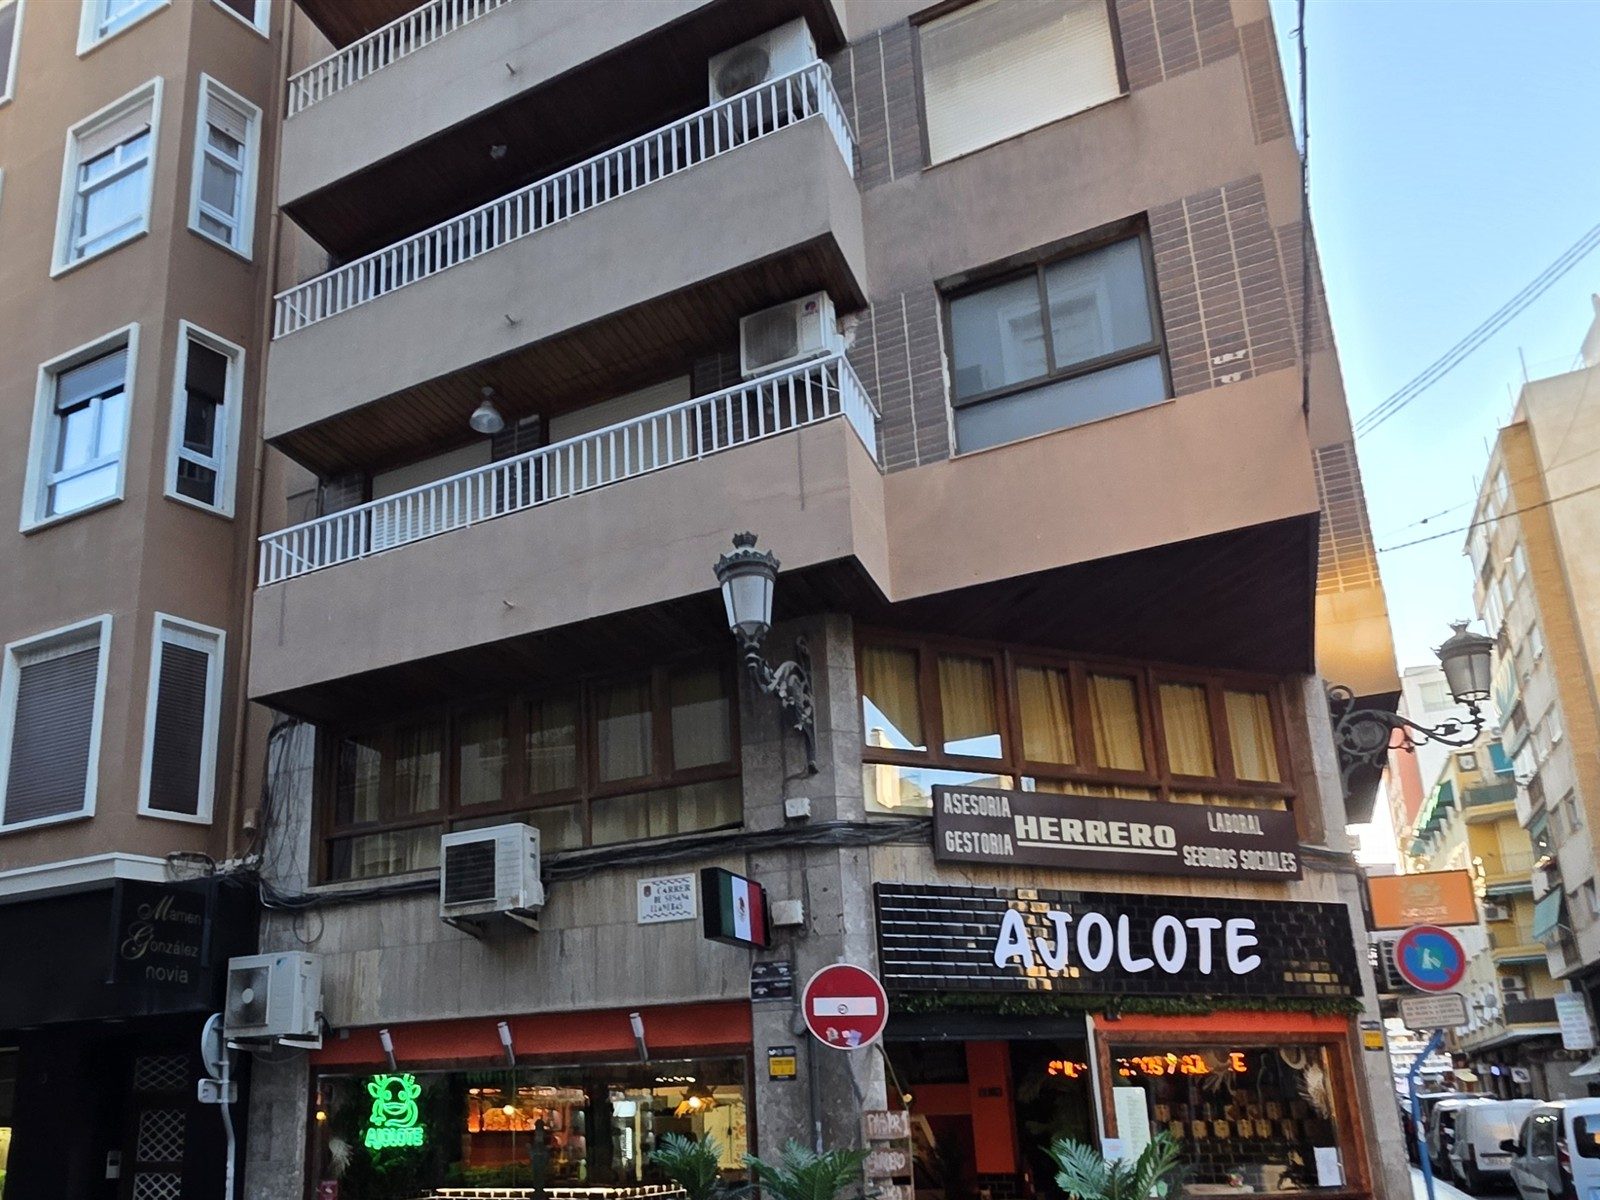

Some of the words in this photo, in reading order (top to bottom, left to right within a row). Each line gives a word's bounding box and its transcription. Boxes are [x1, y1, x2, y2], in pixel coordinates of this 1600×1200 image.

[943, 792, 1012, 818] ASESORIA
[1013, 814, 1177, 849] HERRERO
[1207, 811, 1265, 836] LABORAL
[944, 830, 1014, 856] GESTORIA
[1182, 845, 1238, 870] SEGUROS
[1239, 849, 1298, 873] SOCIALES
[136, 895, 202, 925] Mamen
[121, 921, 199, 960] González
[994, 908, 1261, 975] AJOLOTE
[145, 965, 189, 984] novia
[364, 1127, 424, 1150] AJOLOTE
